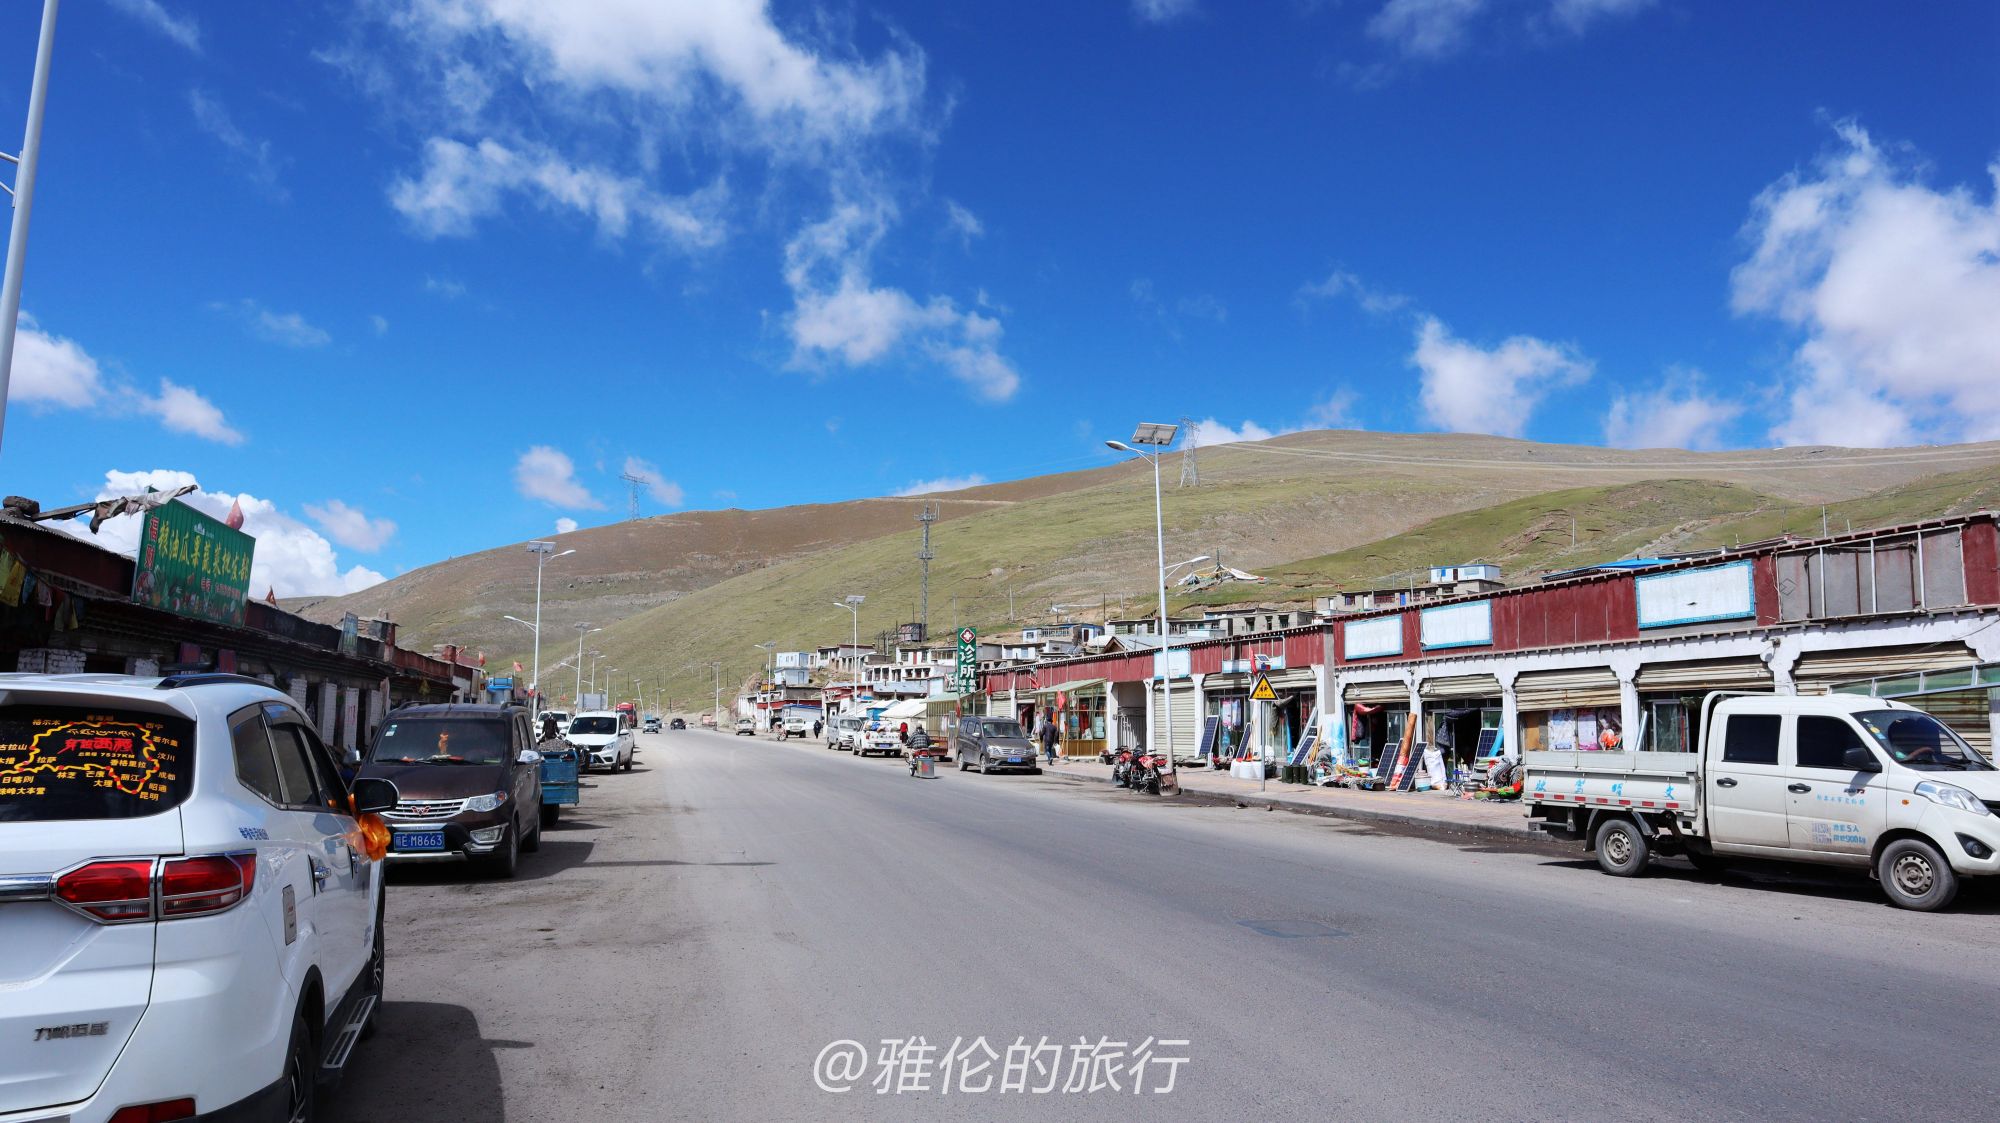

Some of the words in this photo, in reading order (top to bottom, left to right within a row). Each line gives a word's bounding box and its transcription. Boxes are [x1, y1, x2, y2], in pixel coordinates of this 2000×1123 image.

[959, 644, 976, 678] 诊所
[157, 751, 176, 762] 汶川
[110, 759, 147, 769] 香格里拉
[2, 775, 35, 784] 日喀则
[158, 771, 177, 781] 成都
[93, 779, 114, 788] 大理
[139, 791, 160, 802] 昆明
